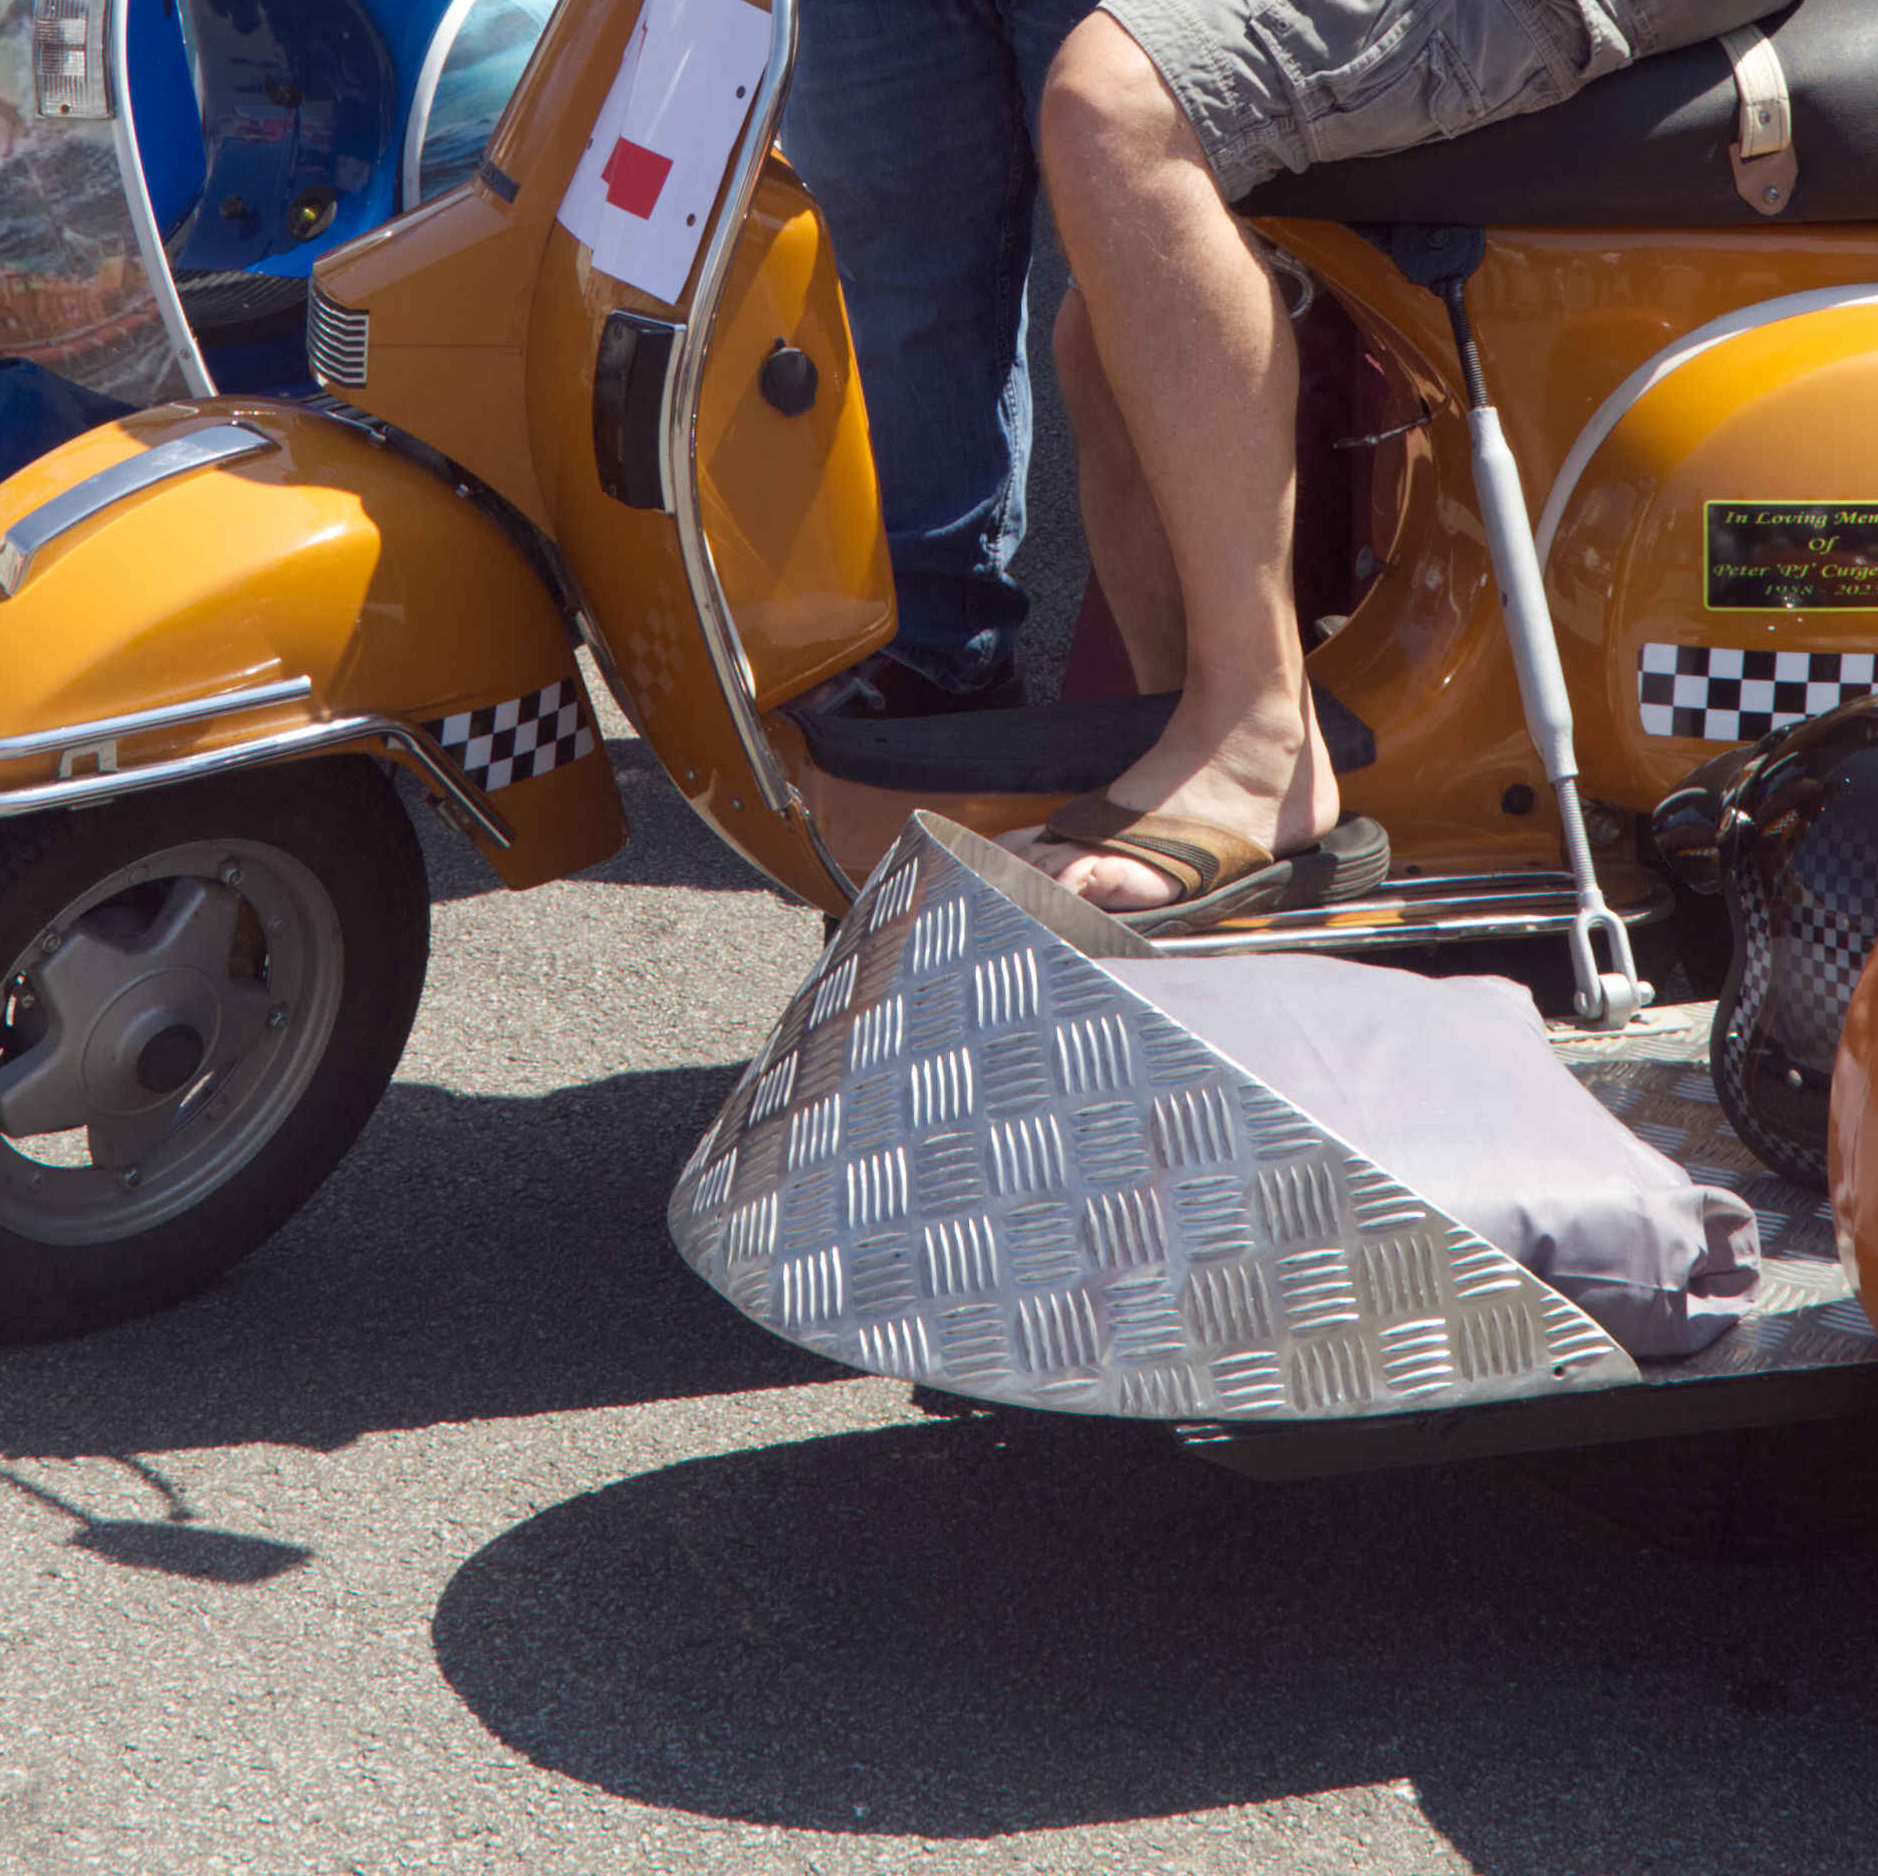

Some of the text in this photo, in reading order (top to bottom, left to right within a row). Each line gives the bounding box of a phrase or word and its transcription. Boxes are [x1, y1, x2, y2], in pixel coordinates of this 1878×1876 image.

[1724, 511, 1749, 524] In
[1754, 510, 1828, 529] Loving
[1808, 535, 1841, 555] Of
[1713, 563, 1770, 577] Peter
[1765, 584, 1814, 596] 1958
